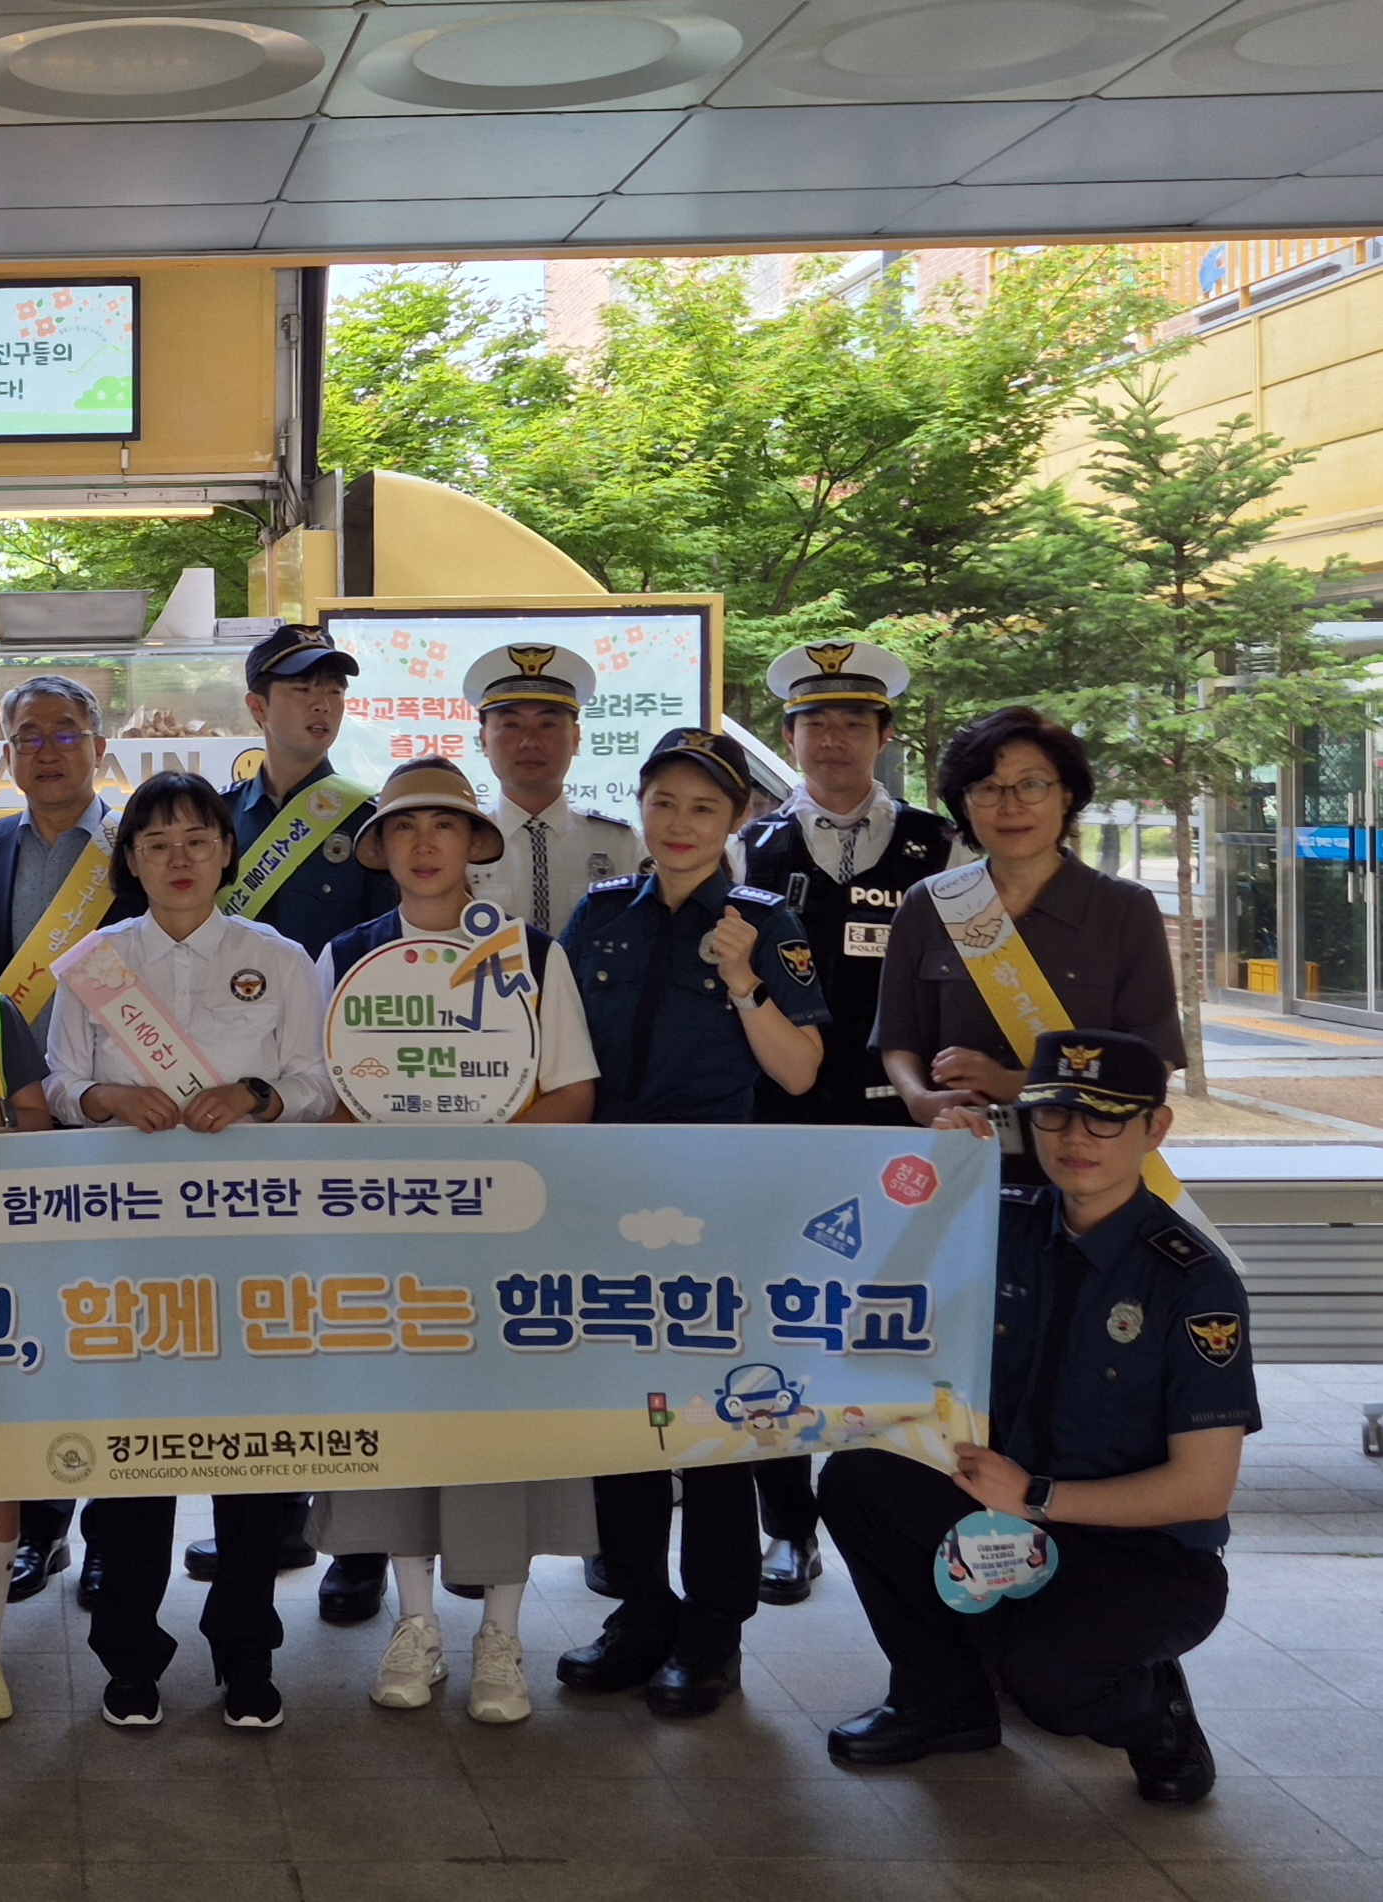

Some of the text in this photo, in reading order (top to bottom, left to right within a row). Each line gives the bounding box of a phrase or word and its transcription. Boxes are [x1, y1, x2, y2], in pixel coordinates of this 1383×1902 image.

[584, 692, 684, 720] 알려주는
[389, 734, 464, 760] 즐거운
[590, 731, 640, 756] 방법
[242, 817, 311, 892] 청소년을
[48, 863, 110, 953] 친구사랑
[850, 886, 905, 908] POLI
[344, 994, 454, 1027] 어린이가
[120, 1004, 178, 1071] 소중한
[396, 1046, 510, 1079] 우선입니다
[889, 1178, 922, 1198] STOP
[895, 1162, 930, 1190] 정지
[1, 1177, 164, 1228] 함께하는
[178, 1175, 301, 1220] 안전한
[317, 1176, 493, 1217] 등하굣길'
[61, 1280, 214, 1356] 함께
[241, 1275, 475, 1351] 만드는
[497, 1274, 742, 1349] 행복한
[766, 1275, 932, 1353] 학교
[106, 1429, 380, 1463] 경기도안성교육지원청
[108, 1462, 380, 1481] GYEONGGIDO ANSEONG OFFICE OF EDUCATION
